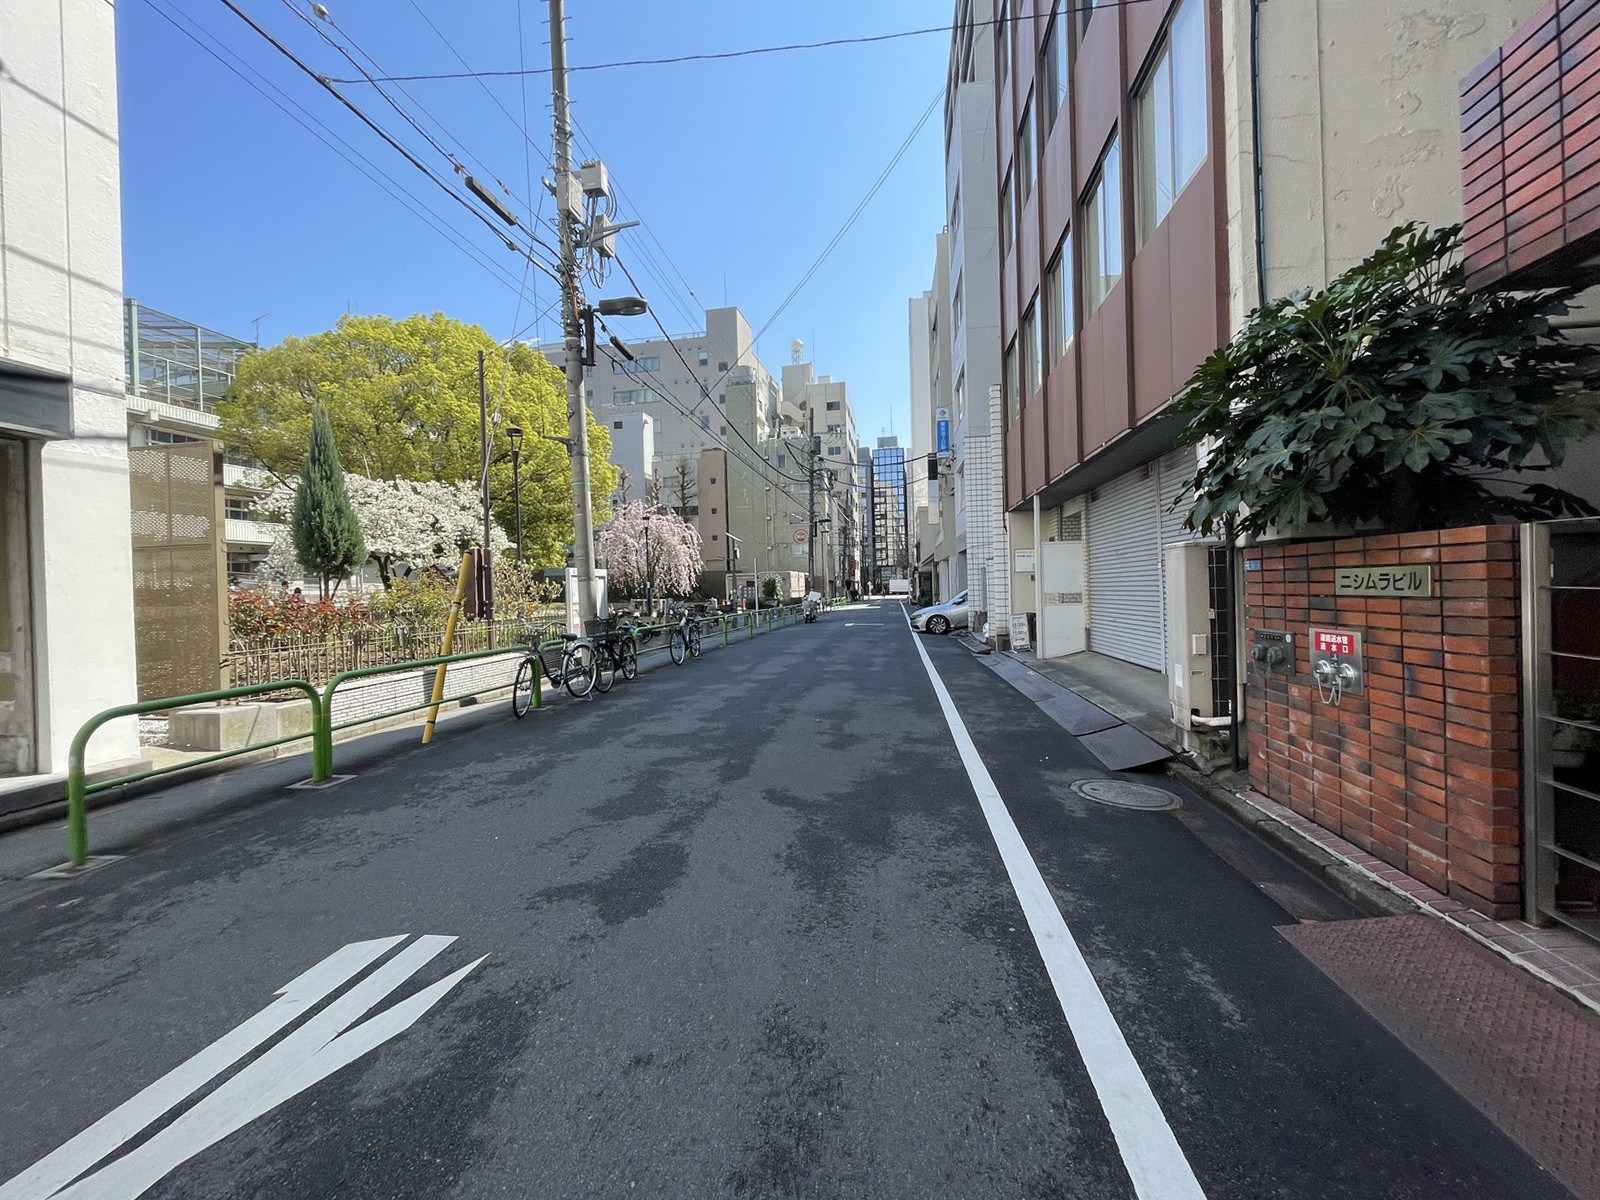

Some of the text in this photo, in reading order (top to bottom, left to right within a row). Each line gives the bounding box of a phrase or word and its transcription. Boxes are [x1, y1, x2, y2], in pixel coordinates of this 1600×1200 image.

[1340, 571, 1422, 591] ニシムラビル
